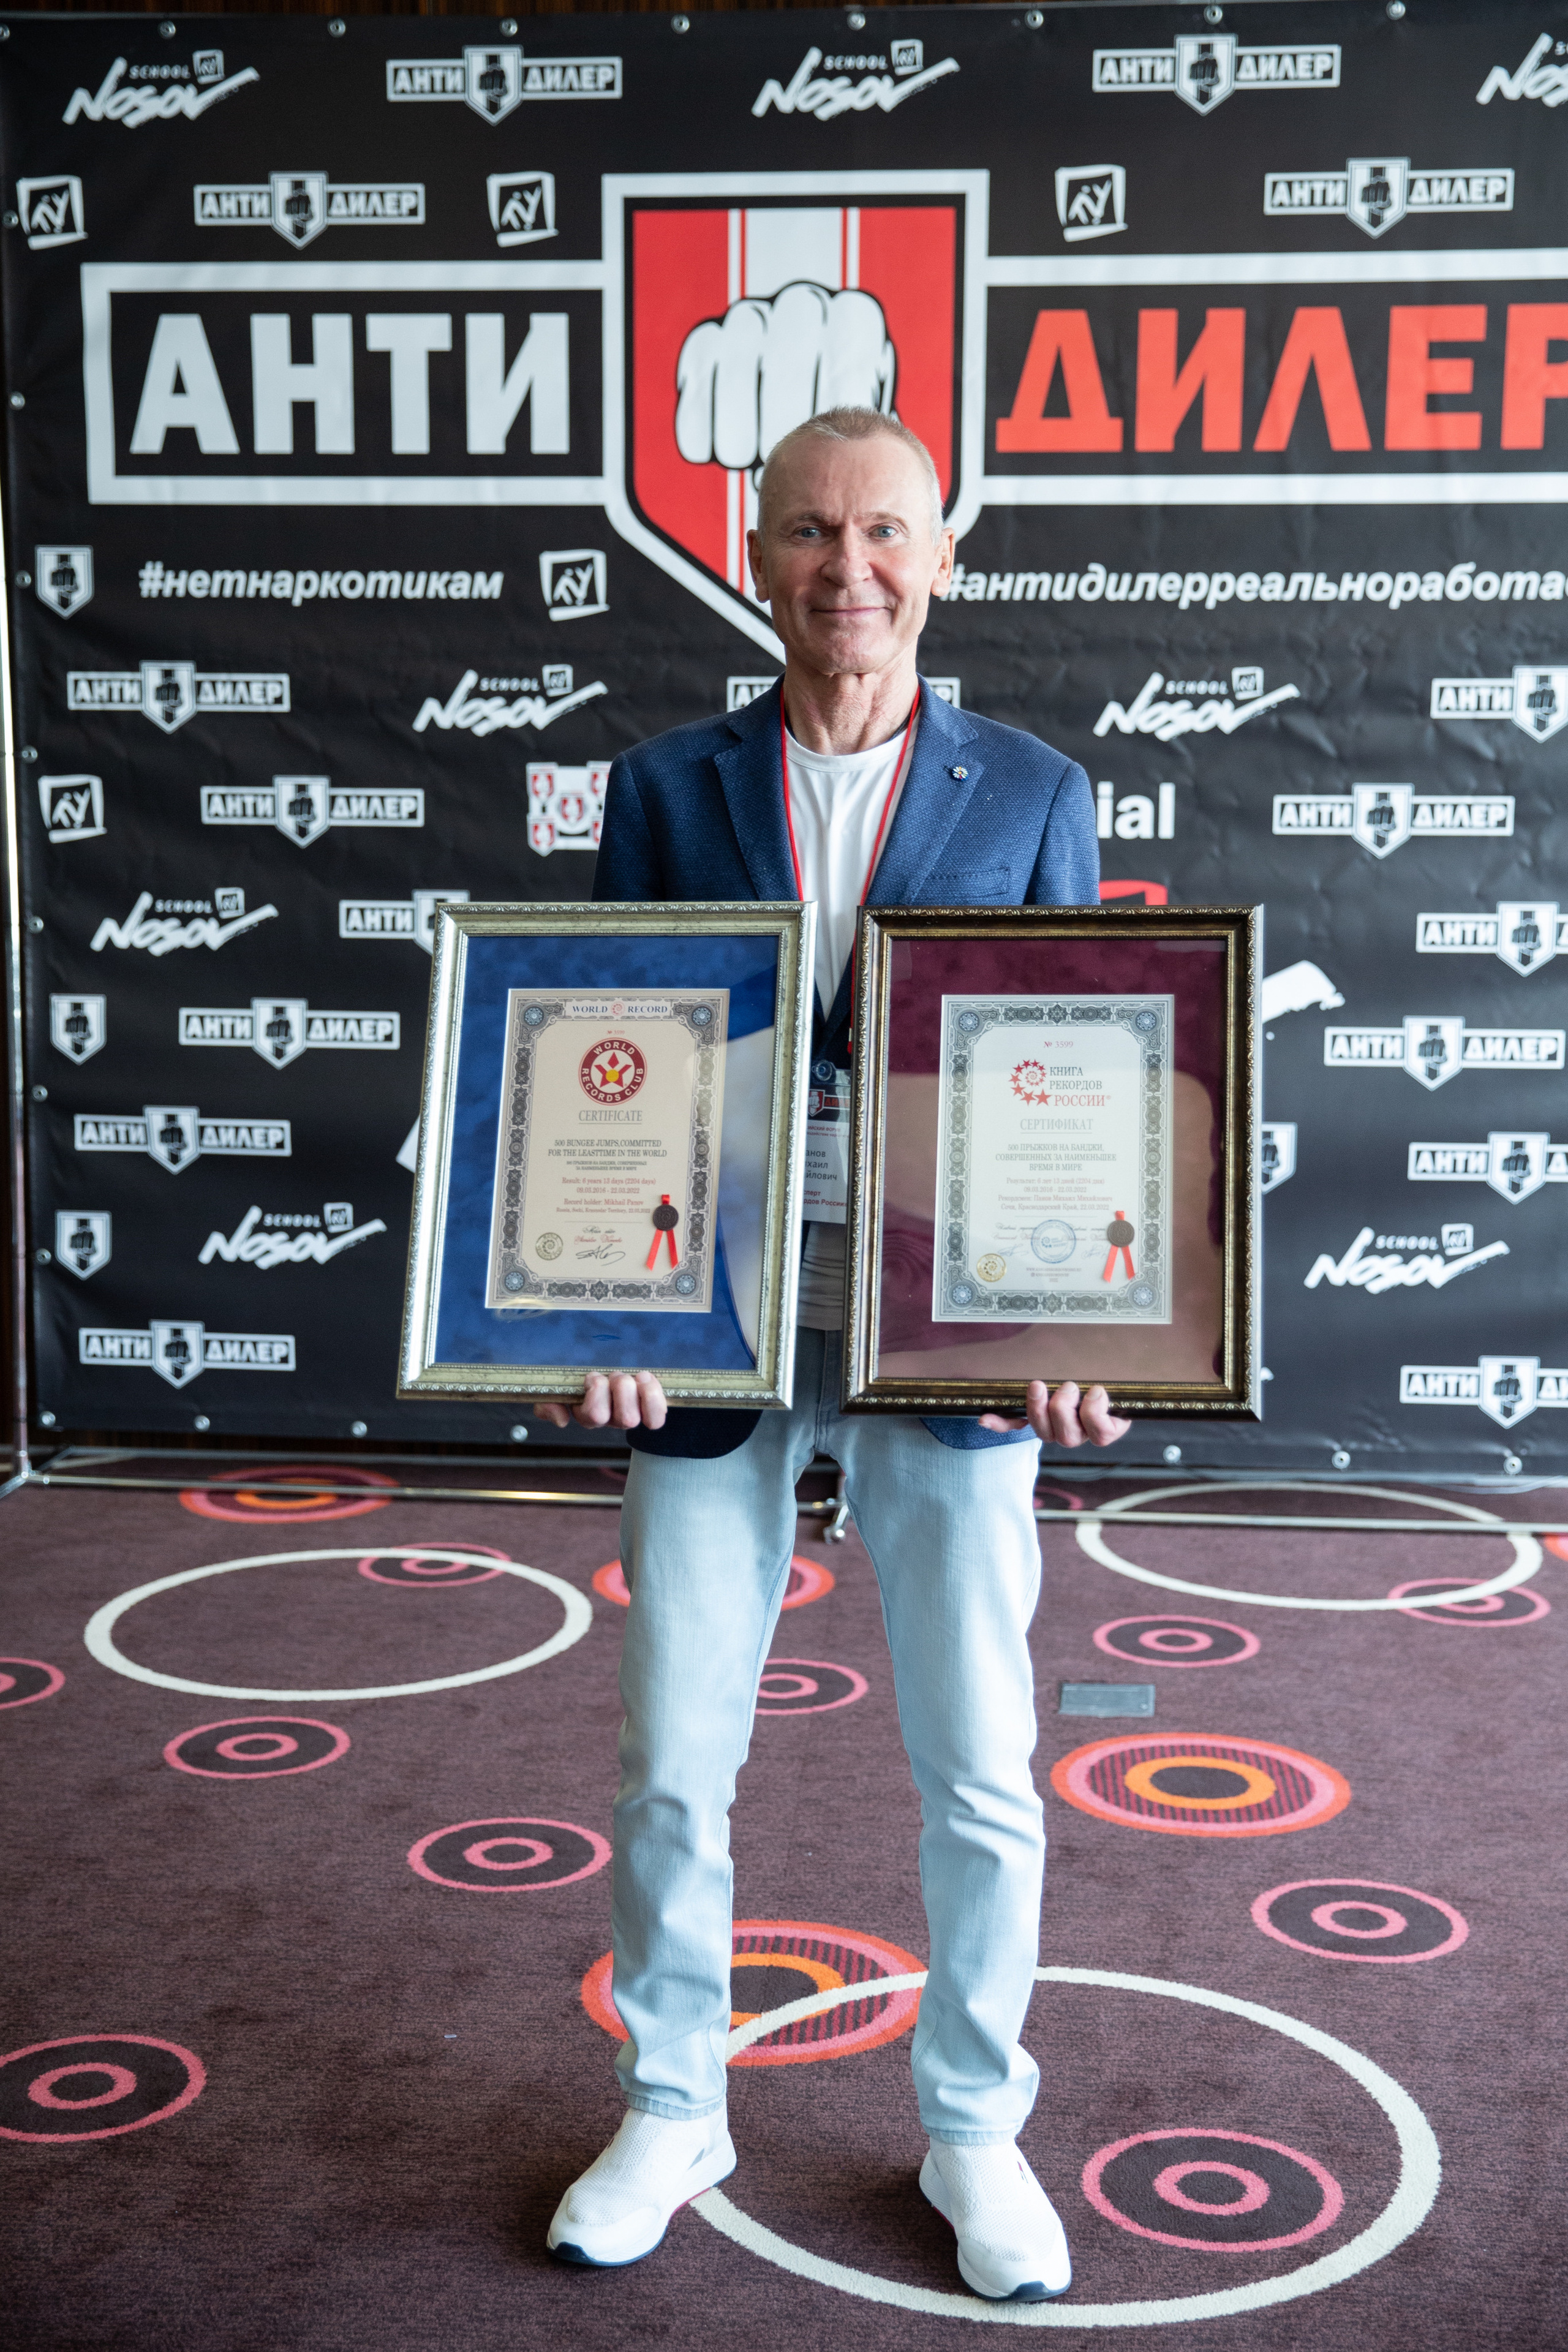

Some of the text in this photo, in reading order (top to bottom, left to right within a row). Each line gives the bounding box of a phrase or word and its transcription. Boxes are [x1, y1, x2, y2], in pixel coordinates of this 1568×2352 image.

[129, 64, 190, 80] SCHOOL
[824, 55, 888, 70] SCHOOL
[1101, 54, 1332, 84] АНТИ ДИЛЕР
[393, 66, 614, 94] АНТИ ДИЛЕР
[1272, 178, 1507, 206] АНТИ ДИЛЕР
[201, 192, 418, 217] АНТИ ДИЛЕР
[129, 303, 1568, 454] АНТИ ДИЛЕР
[139, 562, 503, 607] #нетнаркотикам
[940, 562, 1568, 609] #антидилерреальноработа
[74, 680, 282, 704] АНТИ ДИЛЕР
[480, 678, 540, 692] SCHOOL
[1166, 679, 1227, 694] SCHOOL
[1439, 687, 1513, 712] АНТИ
[208, 795, 417, 820] АНТИ ДИЛЕР
[1097, 780, 1175, 839] ial
[1280, 803, 1507, 828] АНТИ ДИЛЕР
[155, 900, 212, 913] SCHOOL
[345, 909, 413, 931] АНТИ
[1423, 922, 1495, 946] АНТИ
[186, 1016, 395, 1042] АНТИ ДИЛЕР
[594, 1042, 635, 1055] WORLD
[1332, 1035, 1556, 1061] АНТИ ДИЛЕР
[1050, 1067, 1083, 1076] КНИГА
[582, 1068, 643, 1102] RECORDS CLUB
[1050, 1080, 1102, 1090] РЕКОРДОВ
[578, 1110, 643, 1121] CERTIFICATE
[1020, 1118, 1093, 1130] СЕРТИФИКАТ
[81, 1121, 285, 1149] АНТИ ДИЛЕР
[1071, 1144, 1104, 1152] БАНДЖИ,
[1415, 1150, 1487, 1174] АНТИ
[806, 1170, 837, 1180] йлович
[263, 1213, 321, 1227] SCHOOL
[1376, 1235, 1439, 1250] SCHOOL
[86, 1335, 288, 1363] АНТИ ДИЛЕР
[1408, 1374, 1478, 1398] АНТИ
